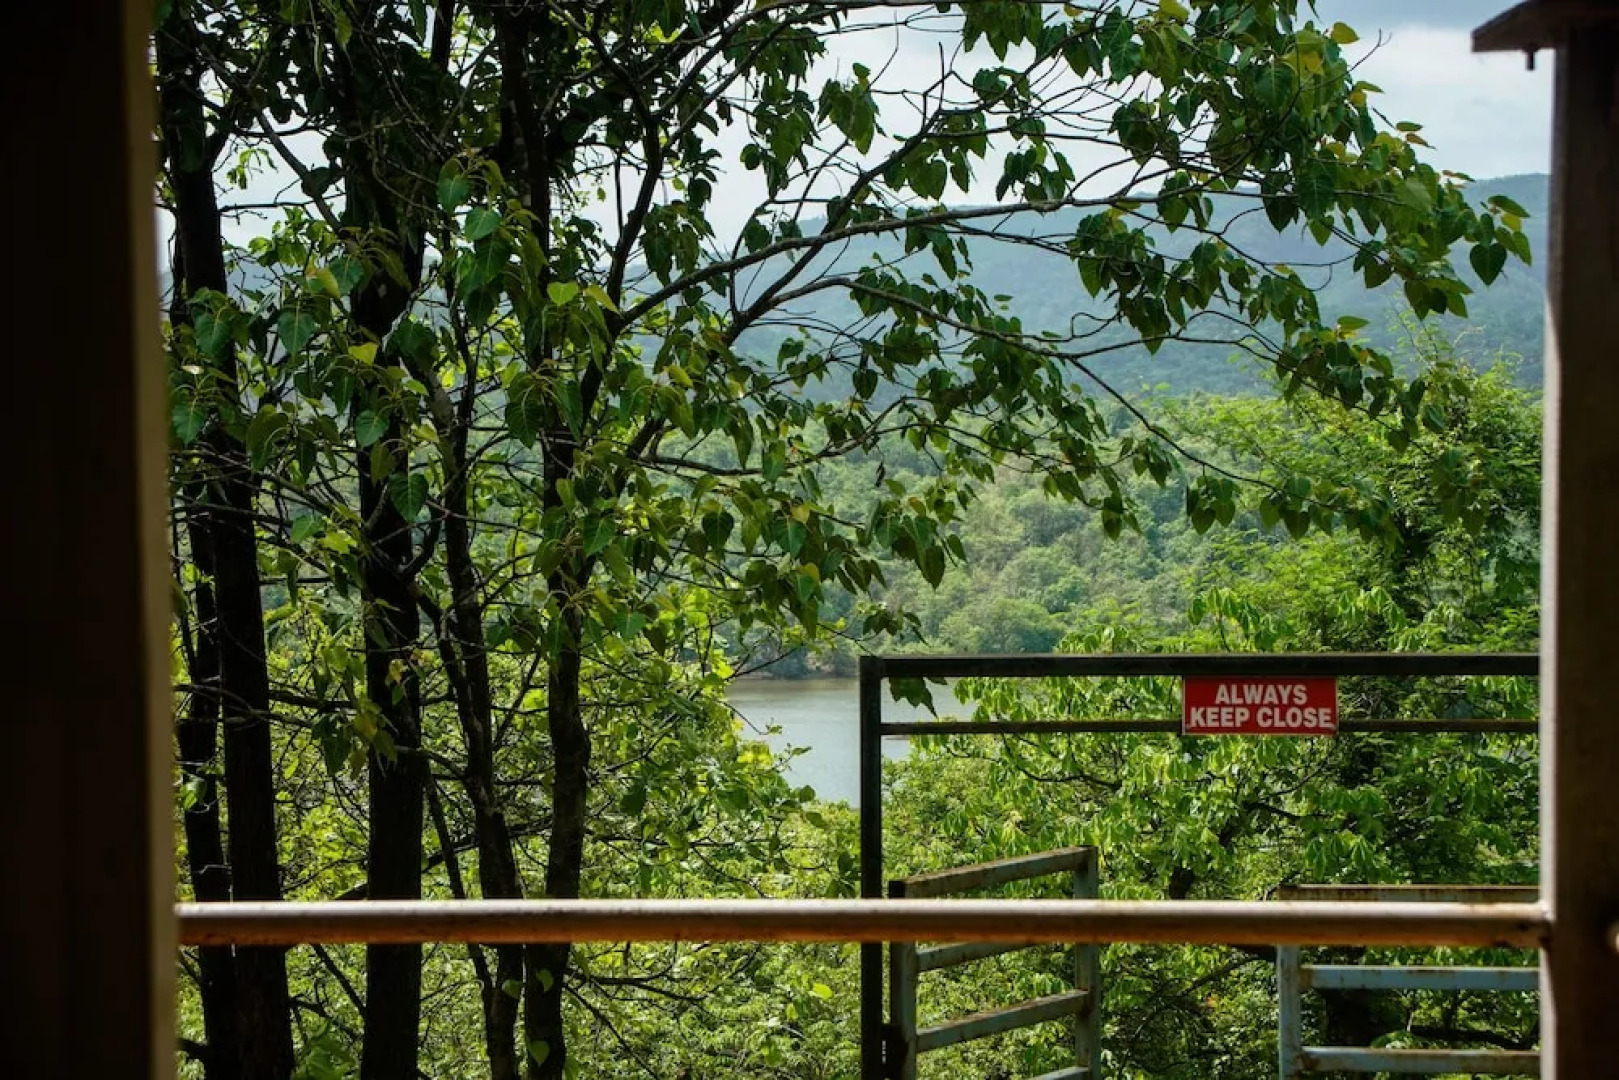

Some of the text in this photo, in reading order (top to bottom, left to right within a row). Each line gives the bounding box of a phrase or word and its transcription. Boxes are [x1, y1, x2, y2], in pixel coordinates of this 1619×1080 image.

[1214, 683, 1308, 705] ALWAYS
[1190, 707, 1332, 728] KEEP CLOSE
